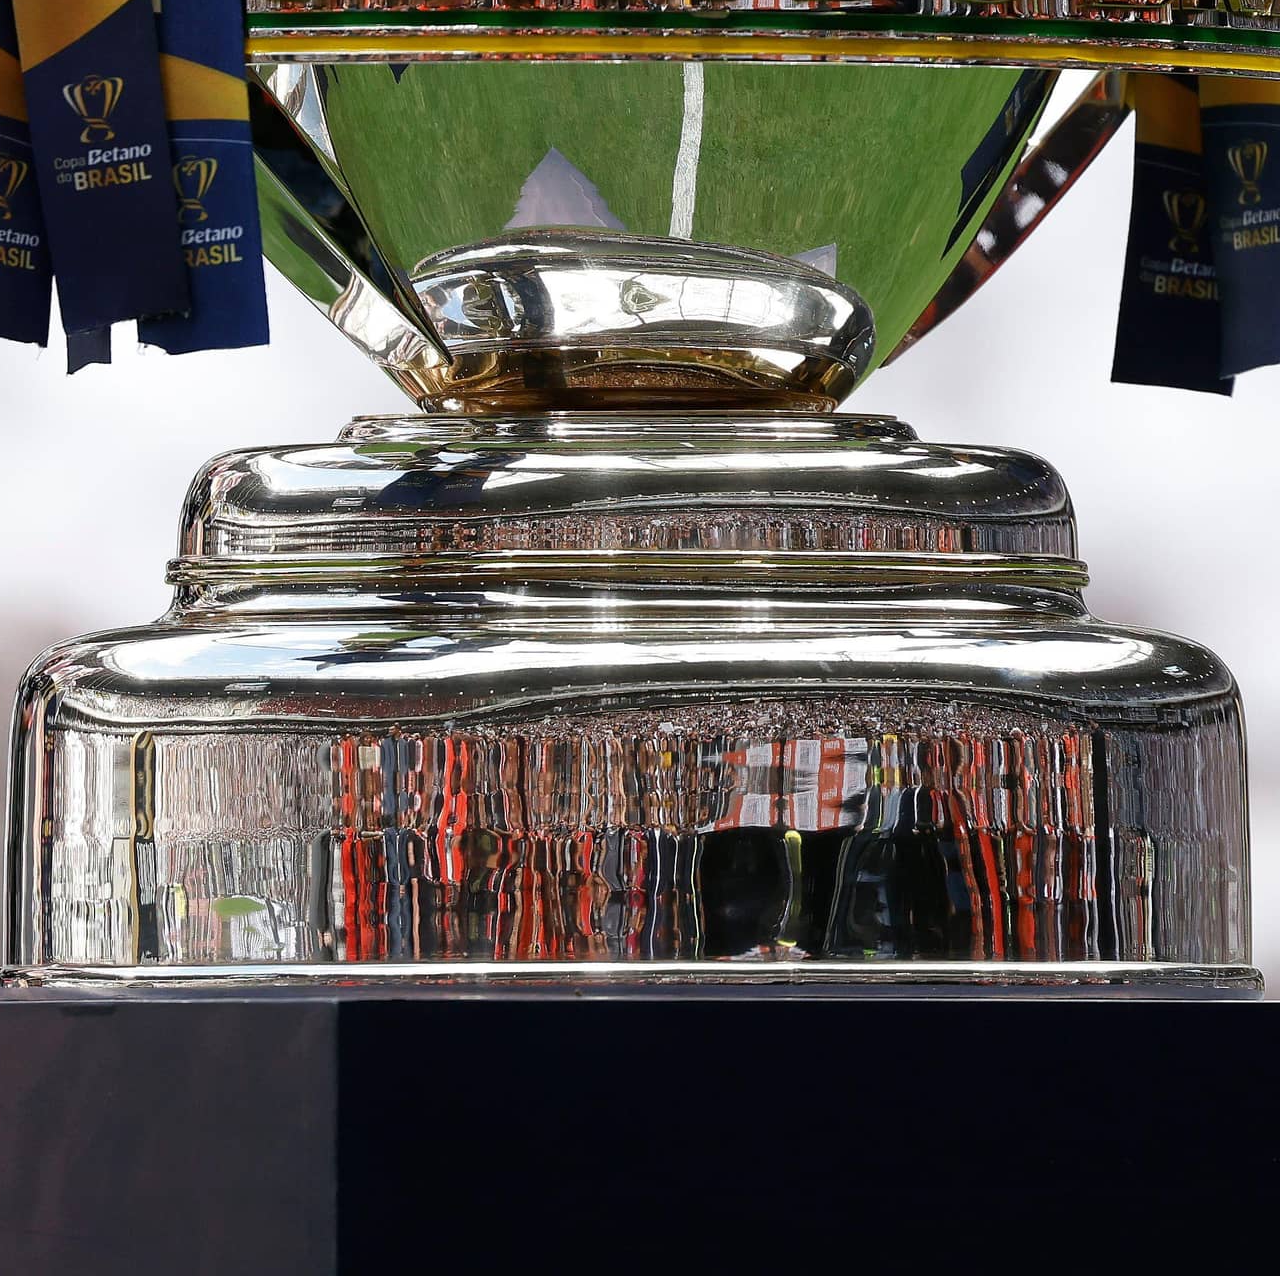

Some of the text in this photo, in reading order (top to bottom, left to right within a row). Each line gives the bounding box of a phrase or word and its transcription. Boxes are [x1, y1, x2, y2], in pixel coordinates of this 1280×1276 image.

[53, 143, 152, 171] Copa Betano
[56, 161, 153, 191] do BRASIL
